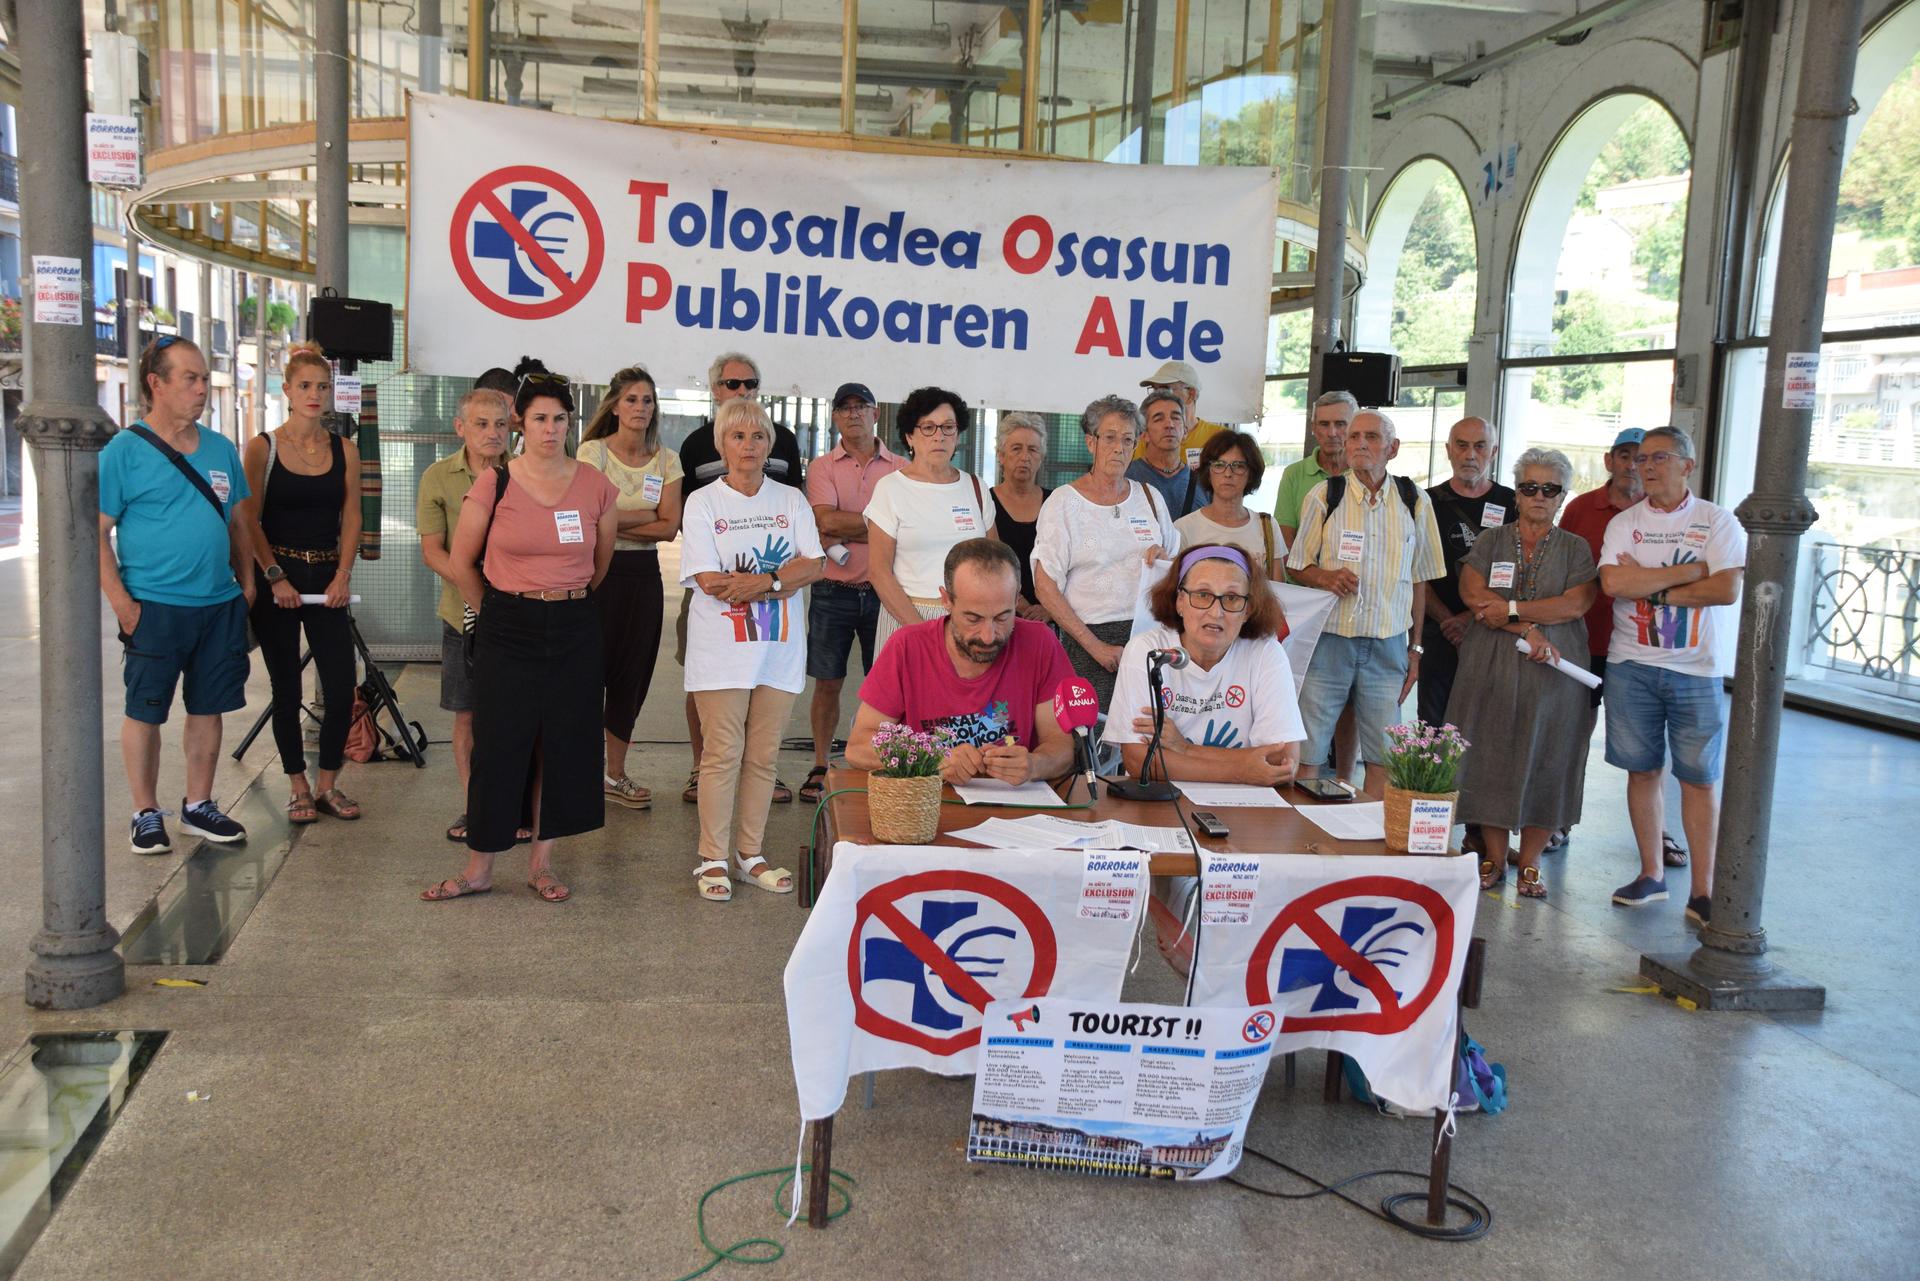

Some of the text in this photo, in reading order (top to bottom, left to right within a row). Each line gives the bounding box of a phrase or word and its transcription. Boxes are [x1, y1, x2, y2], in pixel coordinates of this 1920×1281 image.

[628, 180, 1230, 286] Tolosaldea Osasun
[626, 262, 1224, 364] Publikoaren Alde
[1068, 698, 1095, 707] KANALA
[1087, 861, 1139, 871] BORROKAN
[1208, 862, 1259, 872] BORROKAN
[1068, 1012, 1181, 1038] TOURIST
